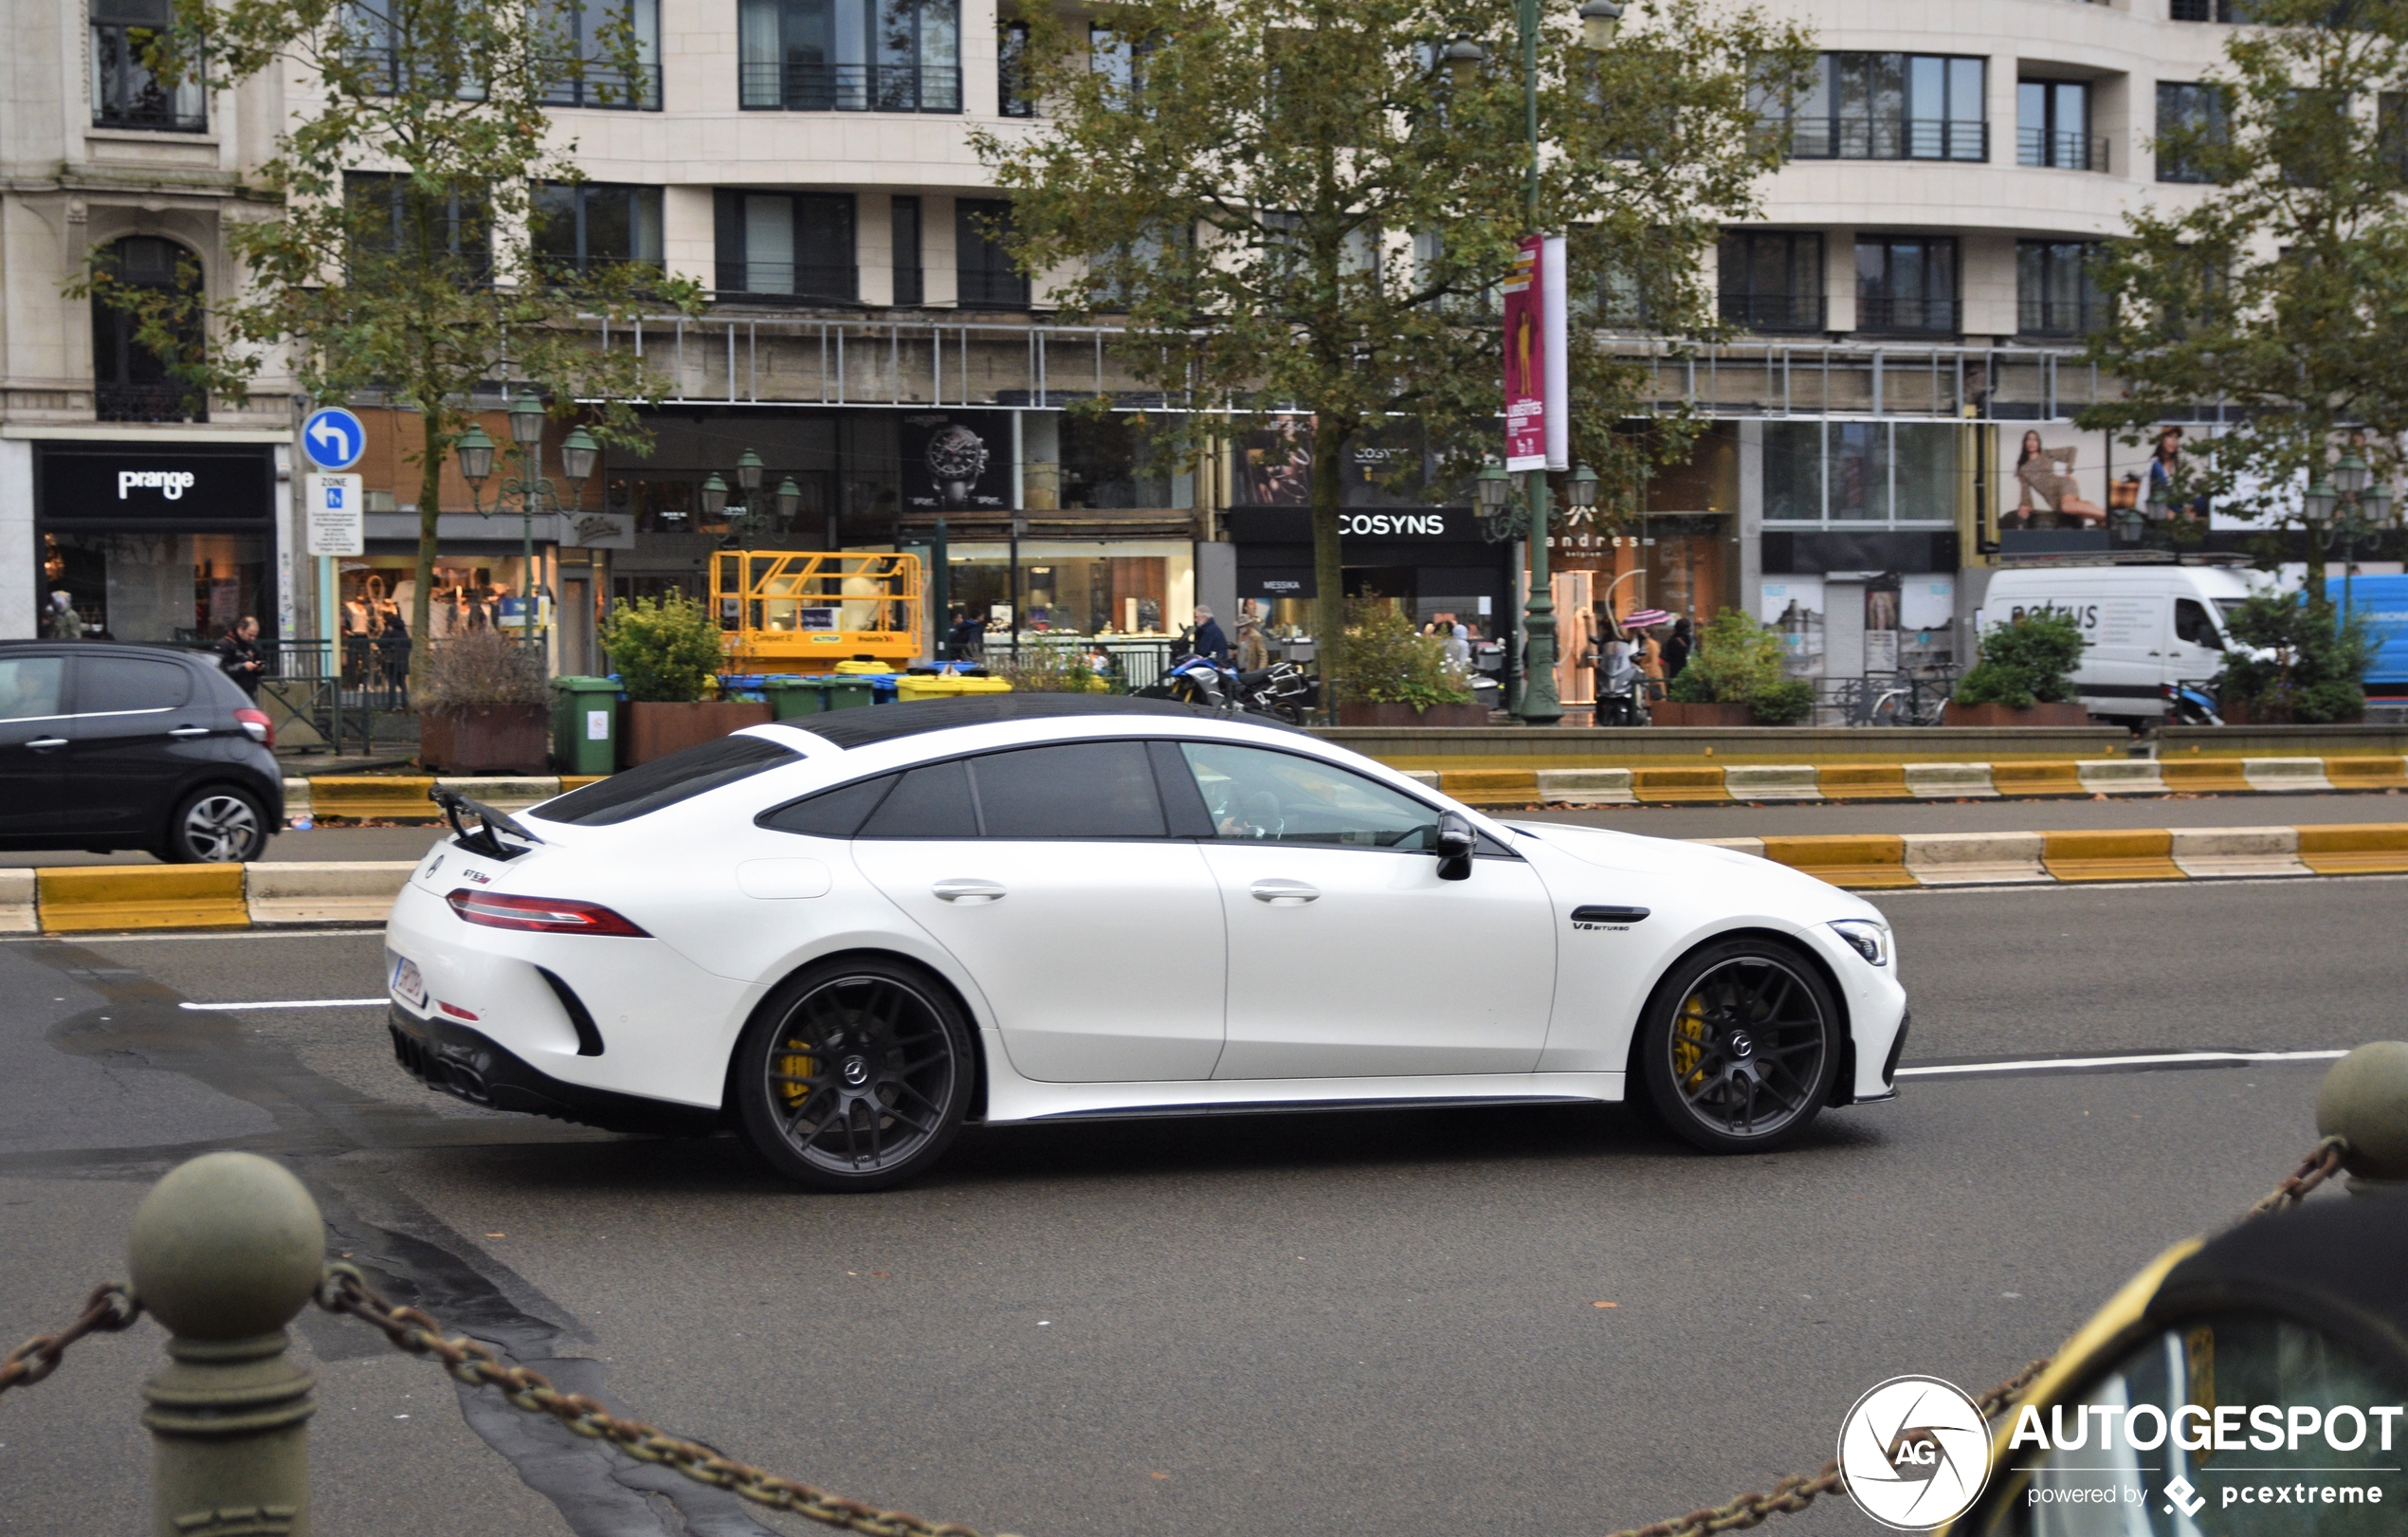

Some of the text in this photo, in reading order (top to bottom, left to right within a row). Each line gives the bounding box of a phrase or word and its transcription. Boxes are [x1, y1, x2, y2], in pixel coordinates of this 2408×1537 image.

[1355, 448, 1410, 459] COSY
[119, 471, 195, 501] prange
[321, 477, 347, 486] ZONE
[1338, 514, 1445, 535] COSYNS
[1264, 580, 1300, 589] MESSIKA
[1573, 922, 1594, 930] V8
